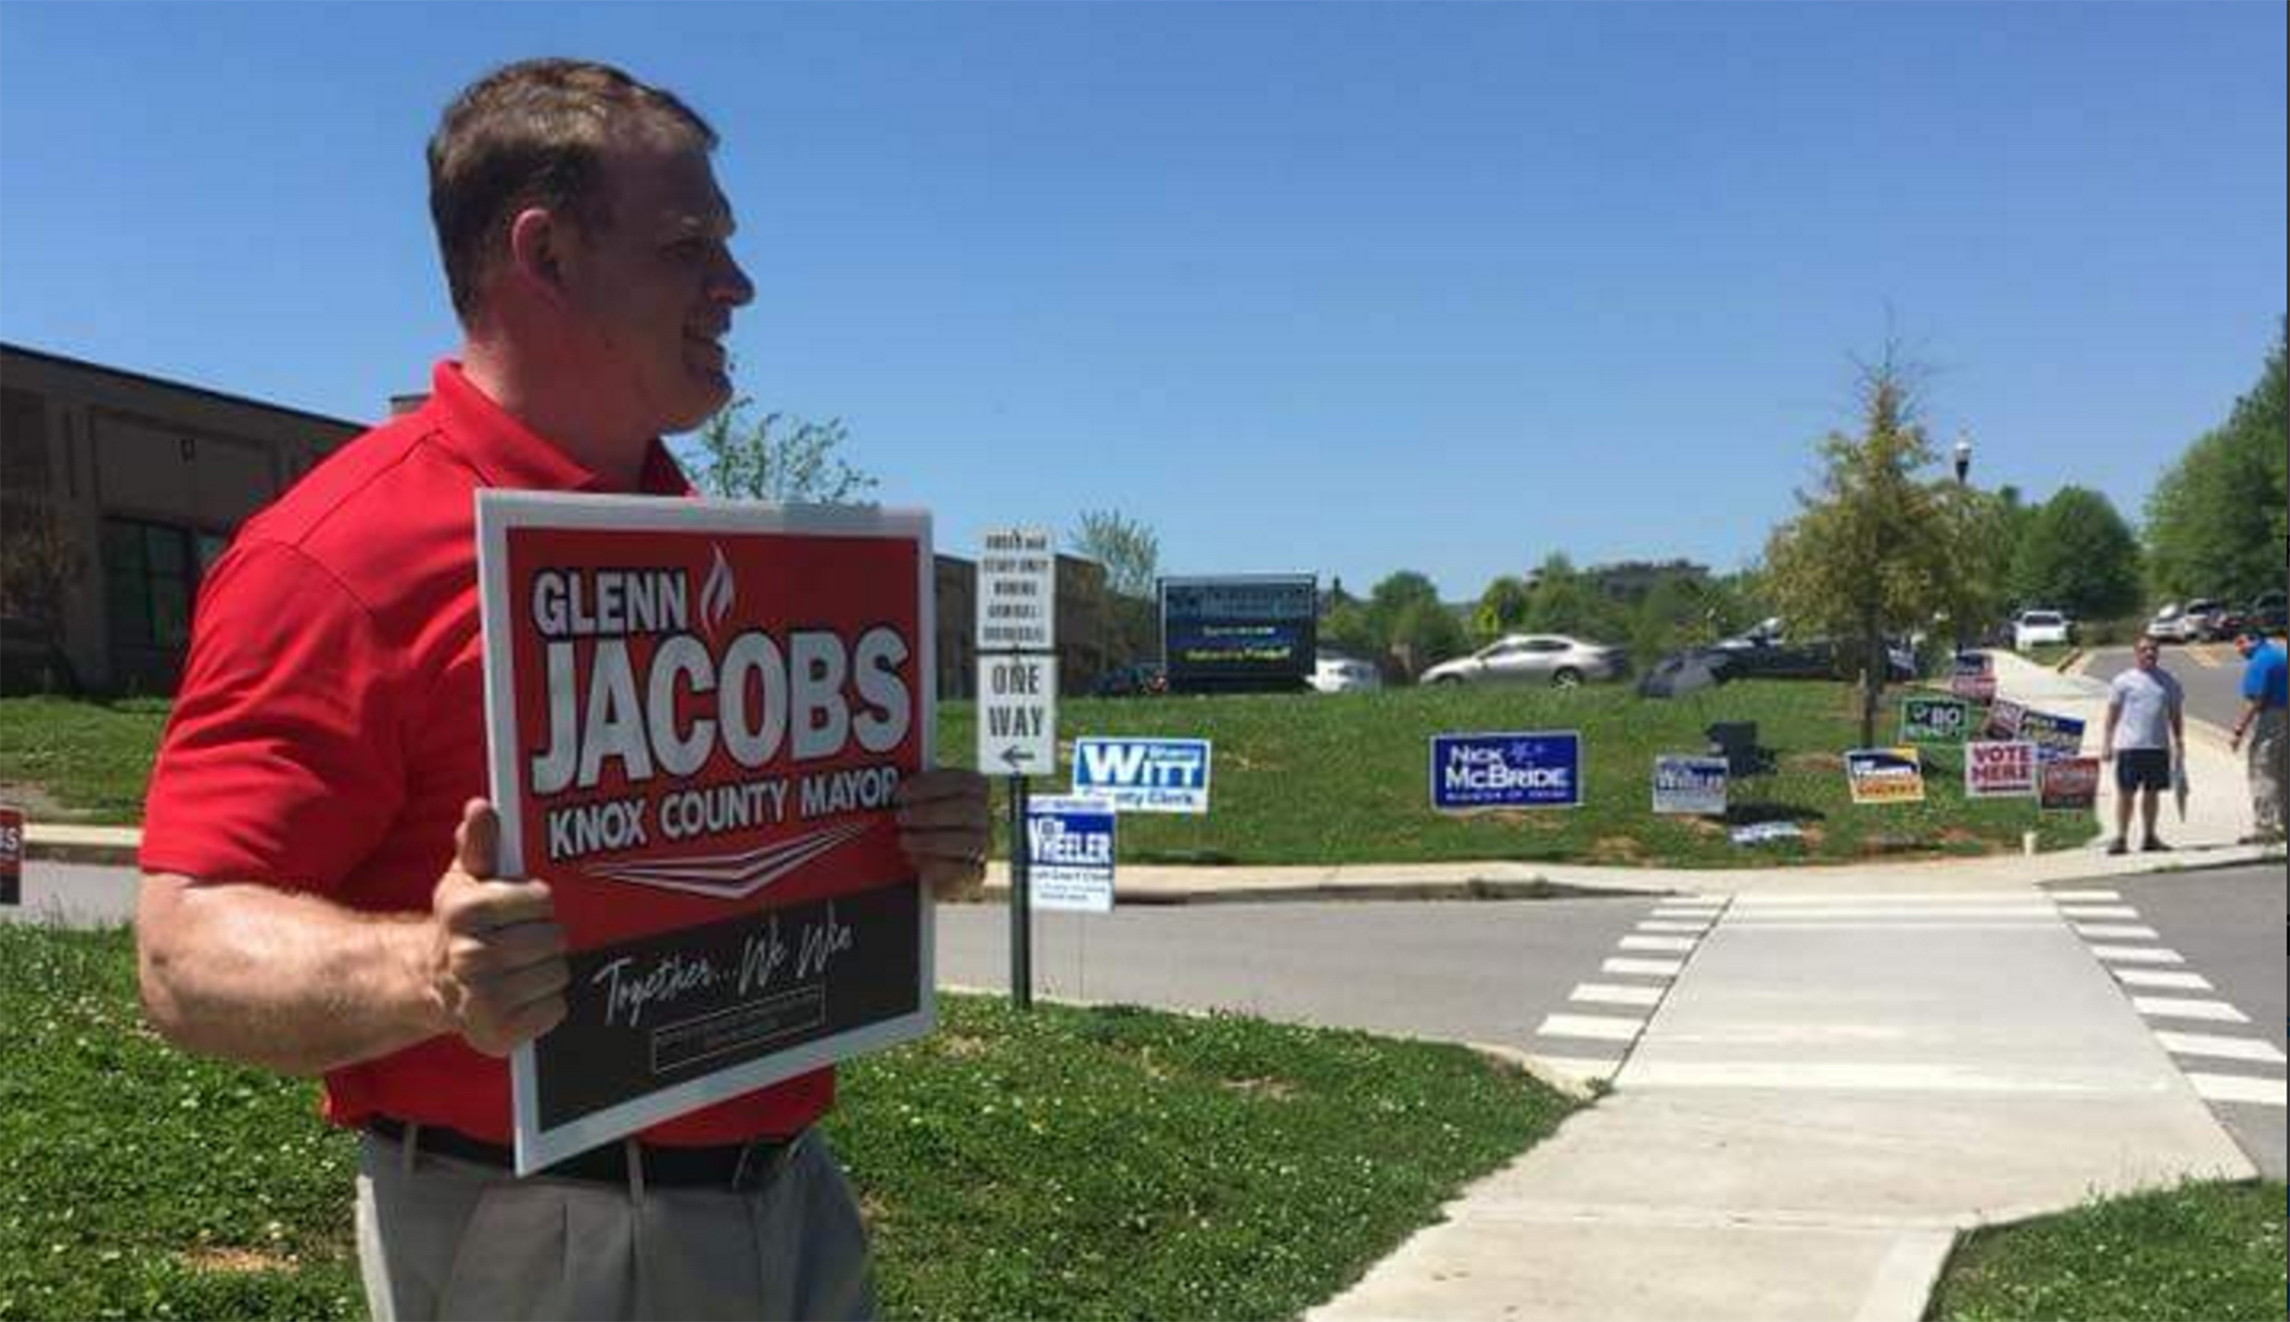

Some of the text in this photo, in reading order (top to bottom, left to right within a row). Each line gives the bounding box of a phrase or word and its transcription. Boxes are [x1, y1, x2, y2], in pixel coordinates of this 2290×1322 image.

[532, 571, 688, 636] GLENN
[992, 664, 1040, 695] ONE
[532, 627, 911, 795] JACOBS
[988, 706, 1043, 738] WAY
[1083, 744, 1200, 786] WITT
[1973, 745, 2032, 763] VOTE
[550, 801, 646, 859] KNOX
[660, 778, 788, 837] COUNTY
